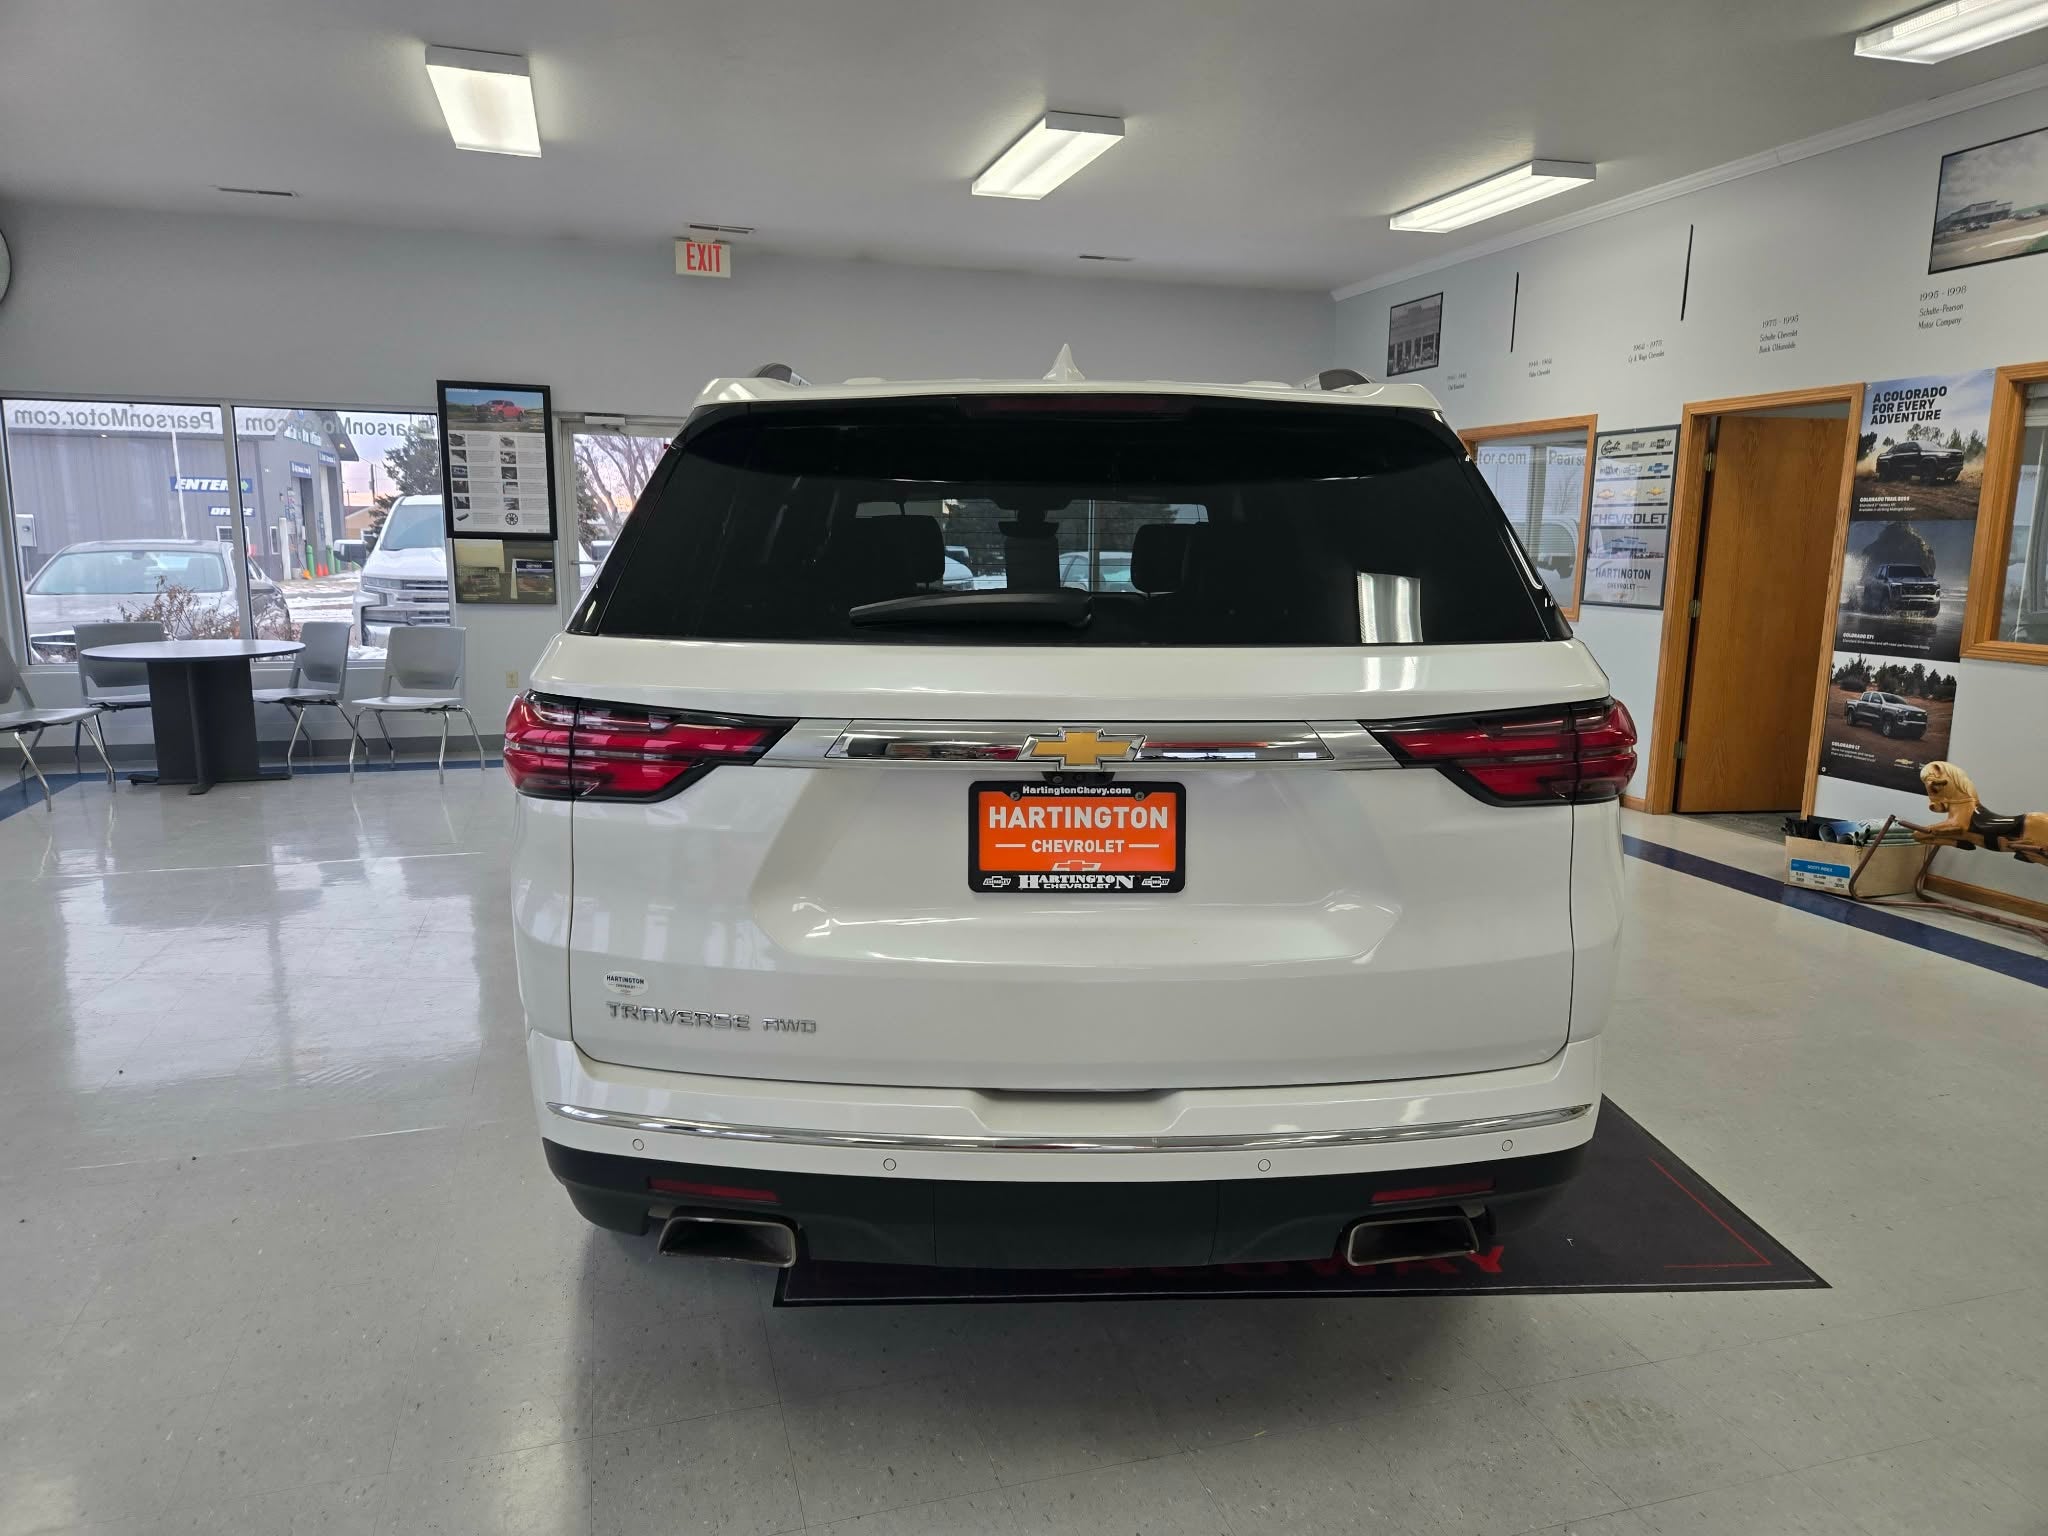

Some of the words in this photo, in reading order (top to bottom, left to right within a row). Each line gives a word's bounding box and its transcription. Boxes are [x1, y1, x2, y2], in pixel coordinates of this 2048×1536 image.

[686, 242, 722, 273] EXIT
[1947, 285, 1967, 296] 1998
[1935, 317, 1962, 328] Company
[1777, 329, 1798, 339] Chevrolet
[1872, 393, 1882, 403] A
[1883, 386, 1948, 402] COLORADO
[1871, 402, 1894, 415] FOR
[1896, 399, 1936, 413] EVERY
[1870, 409, 1942, 426] ADVENTURE
[1592, 513, 1667, 525] CHEVROLET
[1595, 567, 1651, 580] HARTINGTON
[1607, 582, 1636, 590] CHEVROLET
[1831, 741, 1855, 749] COLORADO
[1022, 785, 1132, 796] HartingtonChevy.com
[989, 806, 1168, 829] HARTINGTON
[1031, 839, 1125, 853] CHEVROLET
[1018, 874, 1135, 889] HARTINGTON
[606, 974, 645, 985] HARTINGTON
[606, 1000, 750, 1031] TRAVERSE
[762, 1018, 817, 1034] AWD
